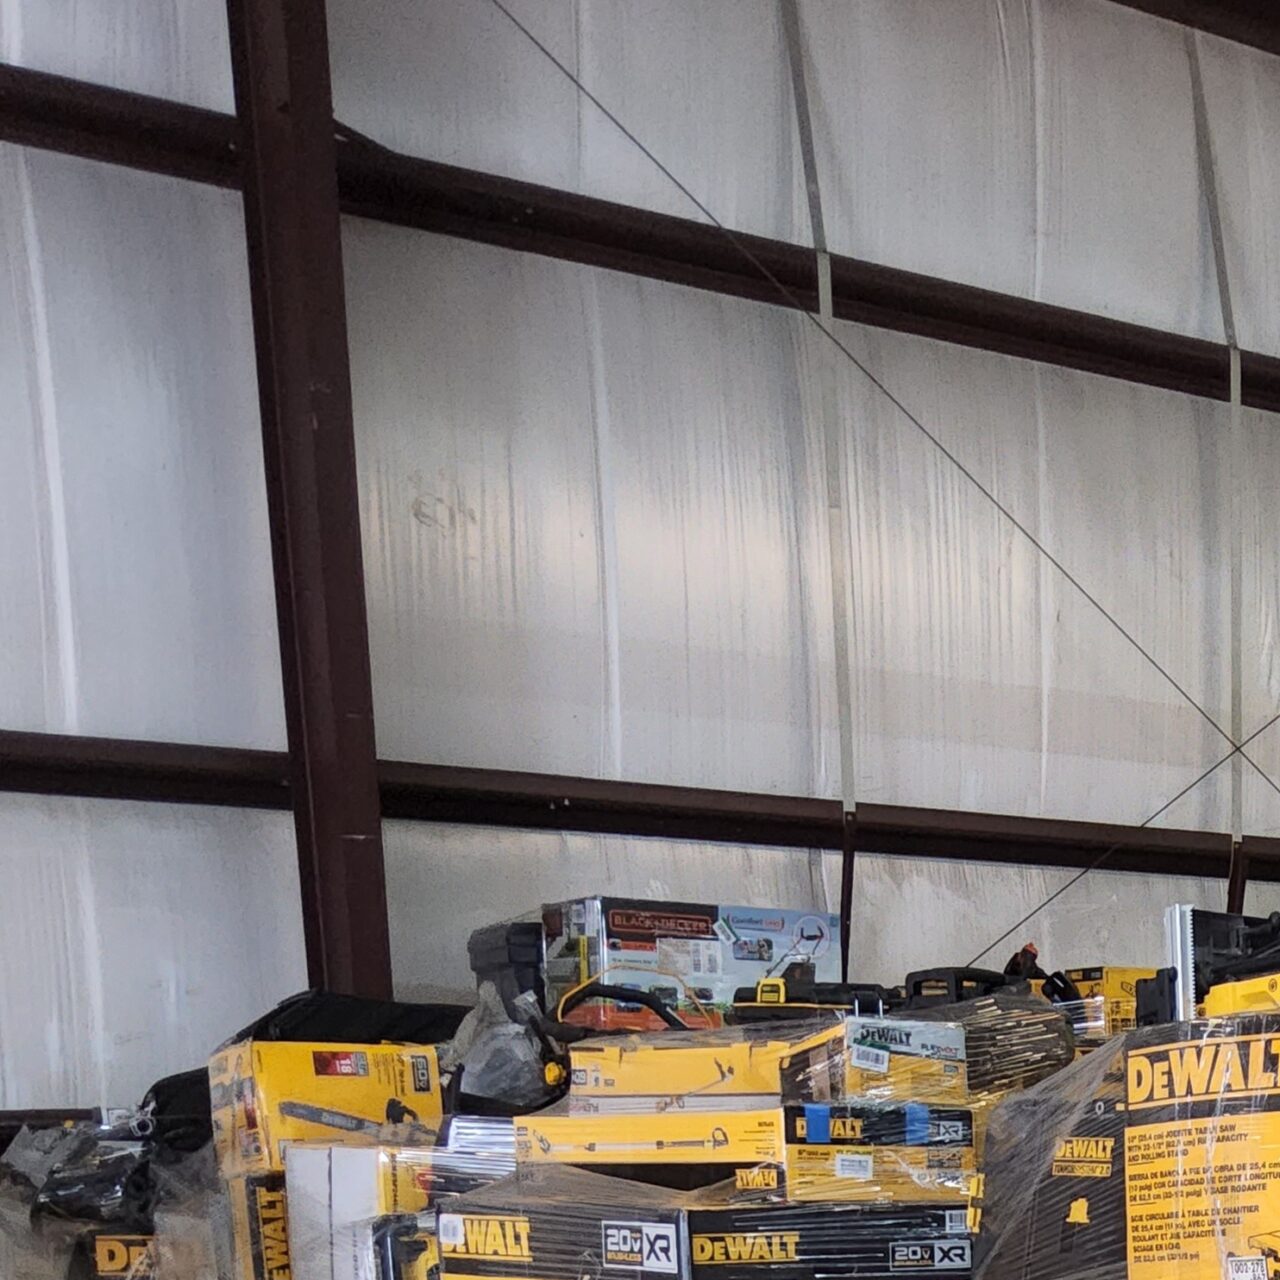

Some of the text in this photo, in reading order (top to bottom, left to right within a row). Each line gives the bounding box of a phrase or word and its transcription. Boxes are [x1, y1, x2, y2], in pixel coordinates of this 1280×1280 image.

[796, 1119, 863, 1137] DALT
[1220, 1124, 1236, 1132] SAW
[1237, 1163, 1246, 1172] DE
[1231, 1183, 1267, 1193] RODANTE
[646, 1233, 672, 1262] XR
[693, 1236, 799, 1262] DEWALT
[938, 1245, 966, 1262] XR
